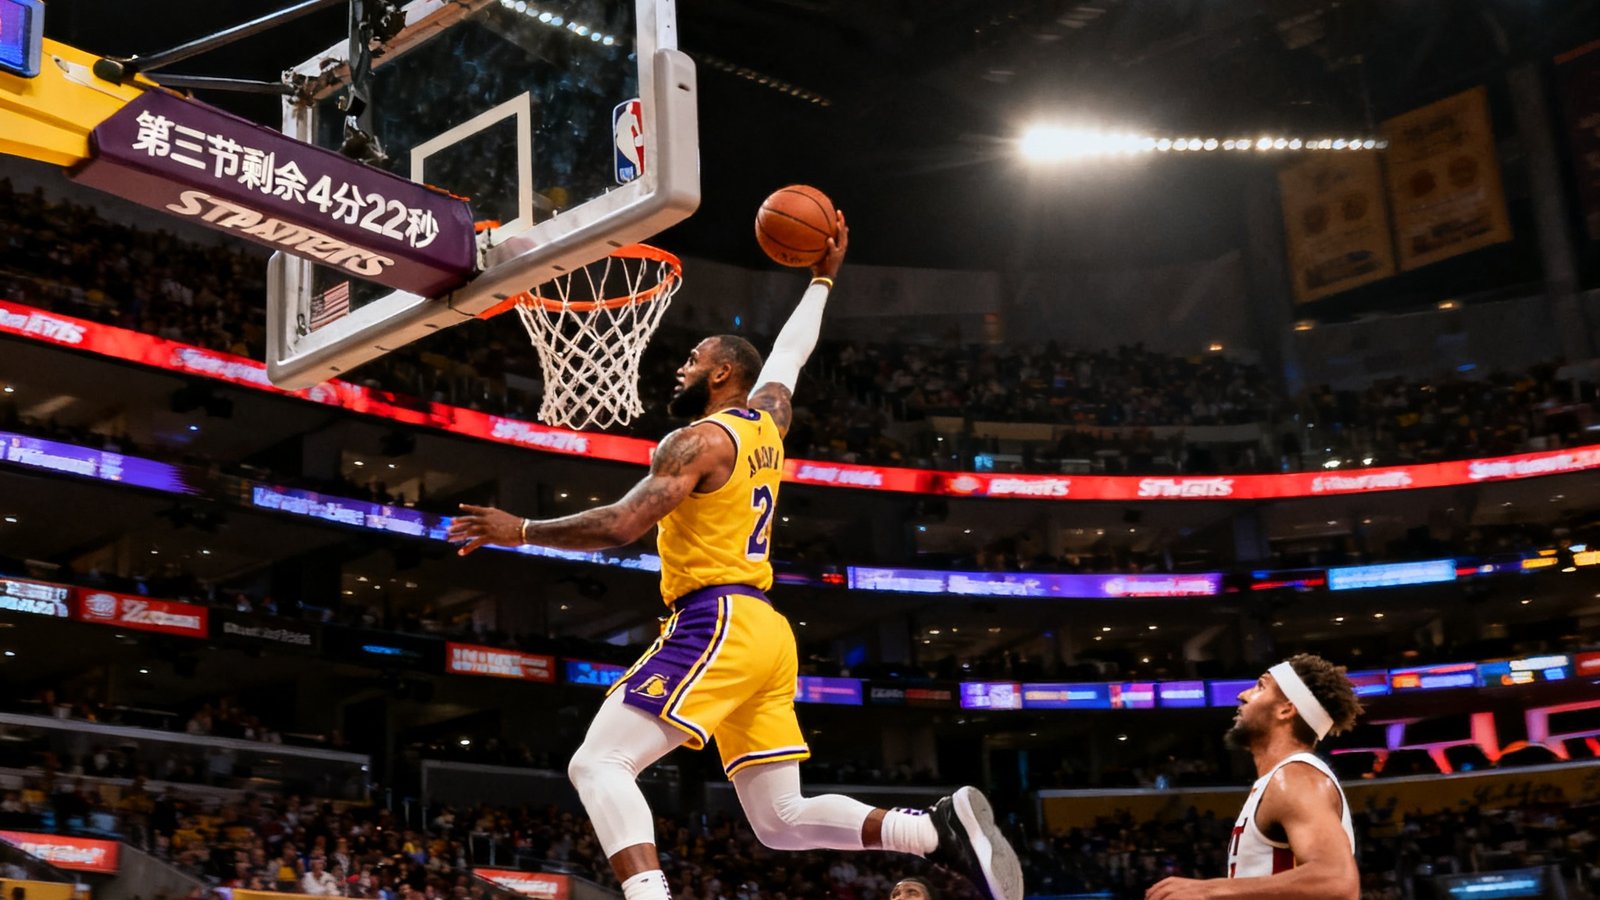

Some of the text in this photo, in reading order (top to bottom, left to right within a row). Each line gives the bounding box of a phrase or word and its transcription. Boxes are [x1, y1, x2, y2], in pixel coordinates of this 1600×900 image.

[132, 110, 440, 250] 第三节剩余4分22秒
